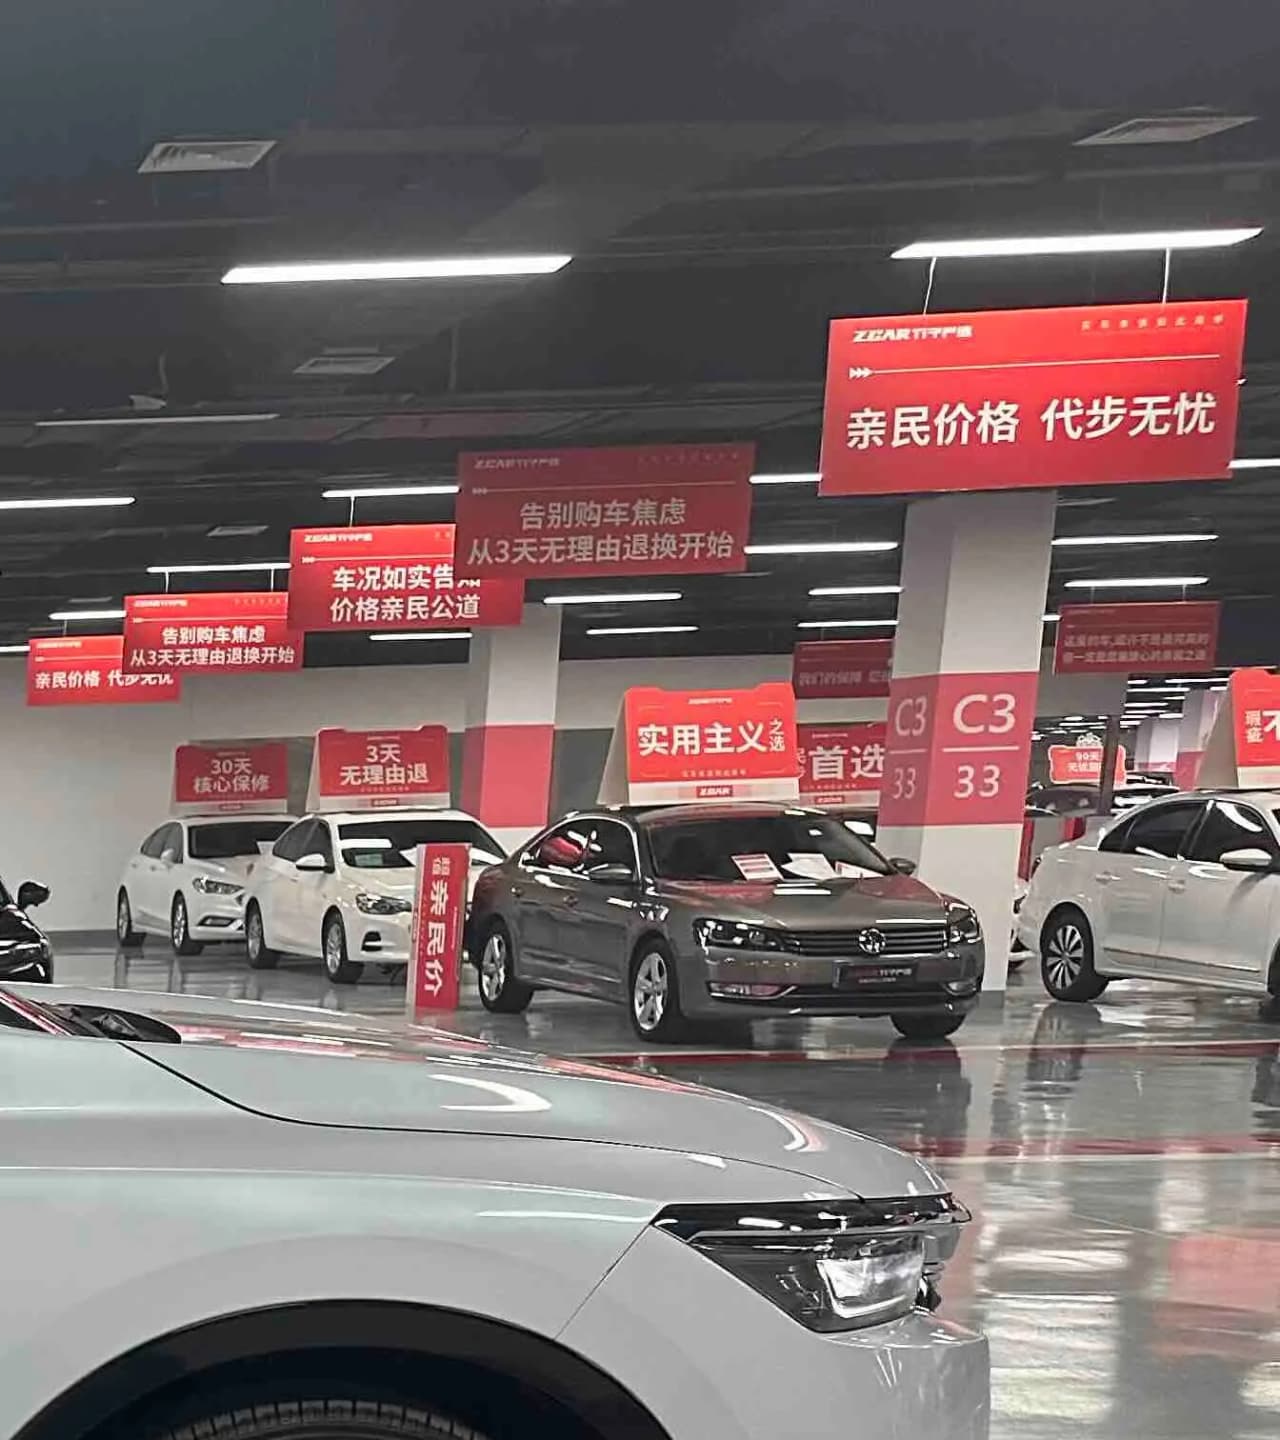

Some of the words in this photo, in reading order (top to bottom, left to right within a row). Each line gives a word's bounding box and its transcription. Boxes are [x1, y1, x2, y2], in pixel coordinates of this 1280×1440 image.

[846, 401, 1019, 450] 亲民价格
[1040, 390, 1217, 441] 代步无忧
[520, 497, 687, 531] 告别购车焦虑
[467, 530, 734, 566] 从3天无理由退换开始
[330, 594, 480, 622] 价格亲民公道
[161, 625, 266, 645] 告别购车焦虑
[130, 646, 295, 667] 从3天无理由退换开始
[35, 670, 101, 689] 亲民价格
[895, 695, 927, 738] C3
[952, 693, 1016, 734] C3
[637, 720, 768, 757] 实用主义
[768, 718, 786, 752] 之选
[210, 758, 253, 775] 30天
[366, 743, 401, 763] 3天
[193, 774, 270, 793] 核心保修
[339, 763, 429, 786] 无理由退
[892, 767, 918, 800] 33
[953, 764, 1001, 799] 33
[424, 879, 449, 998] 亲民价
